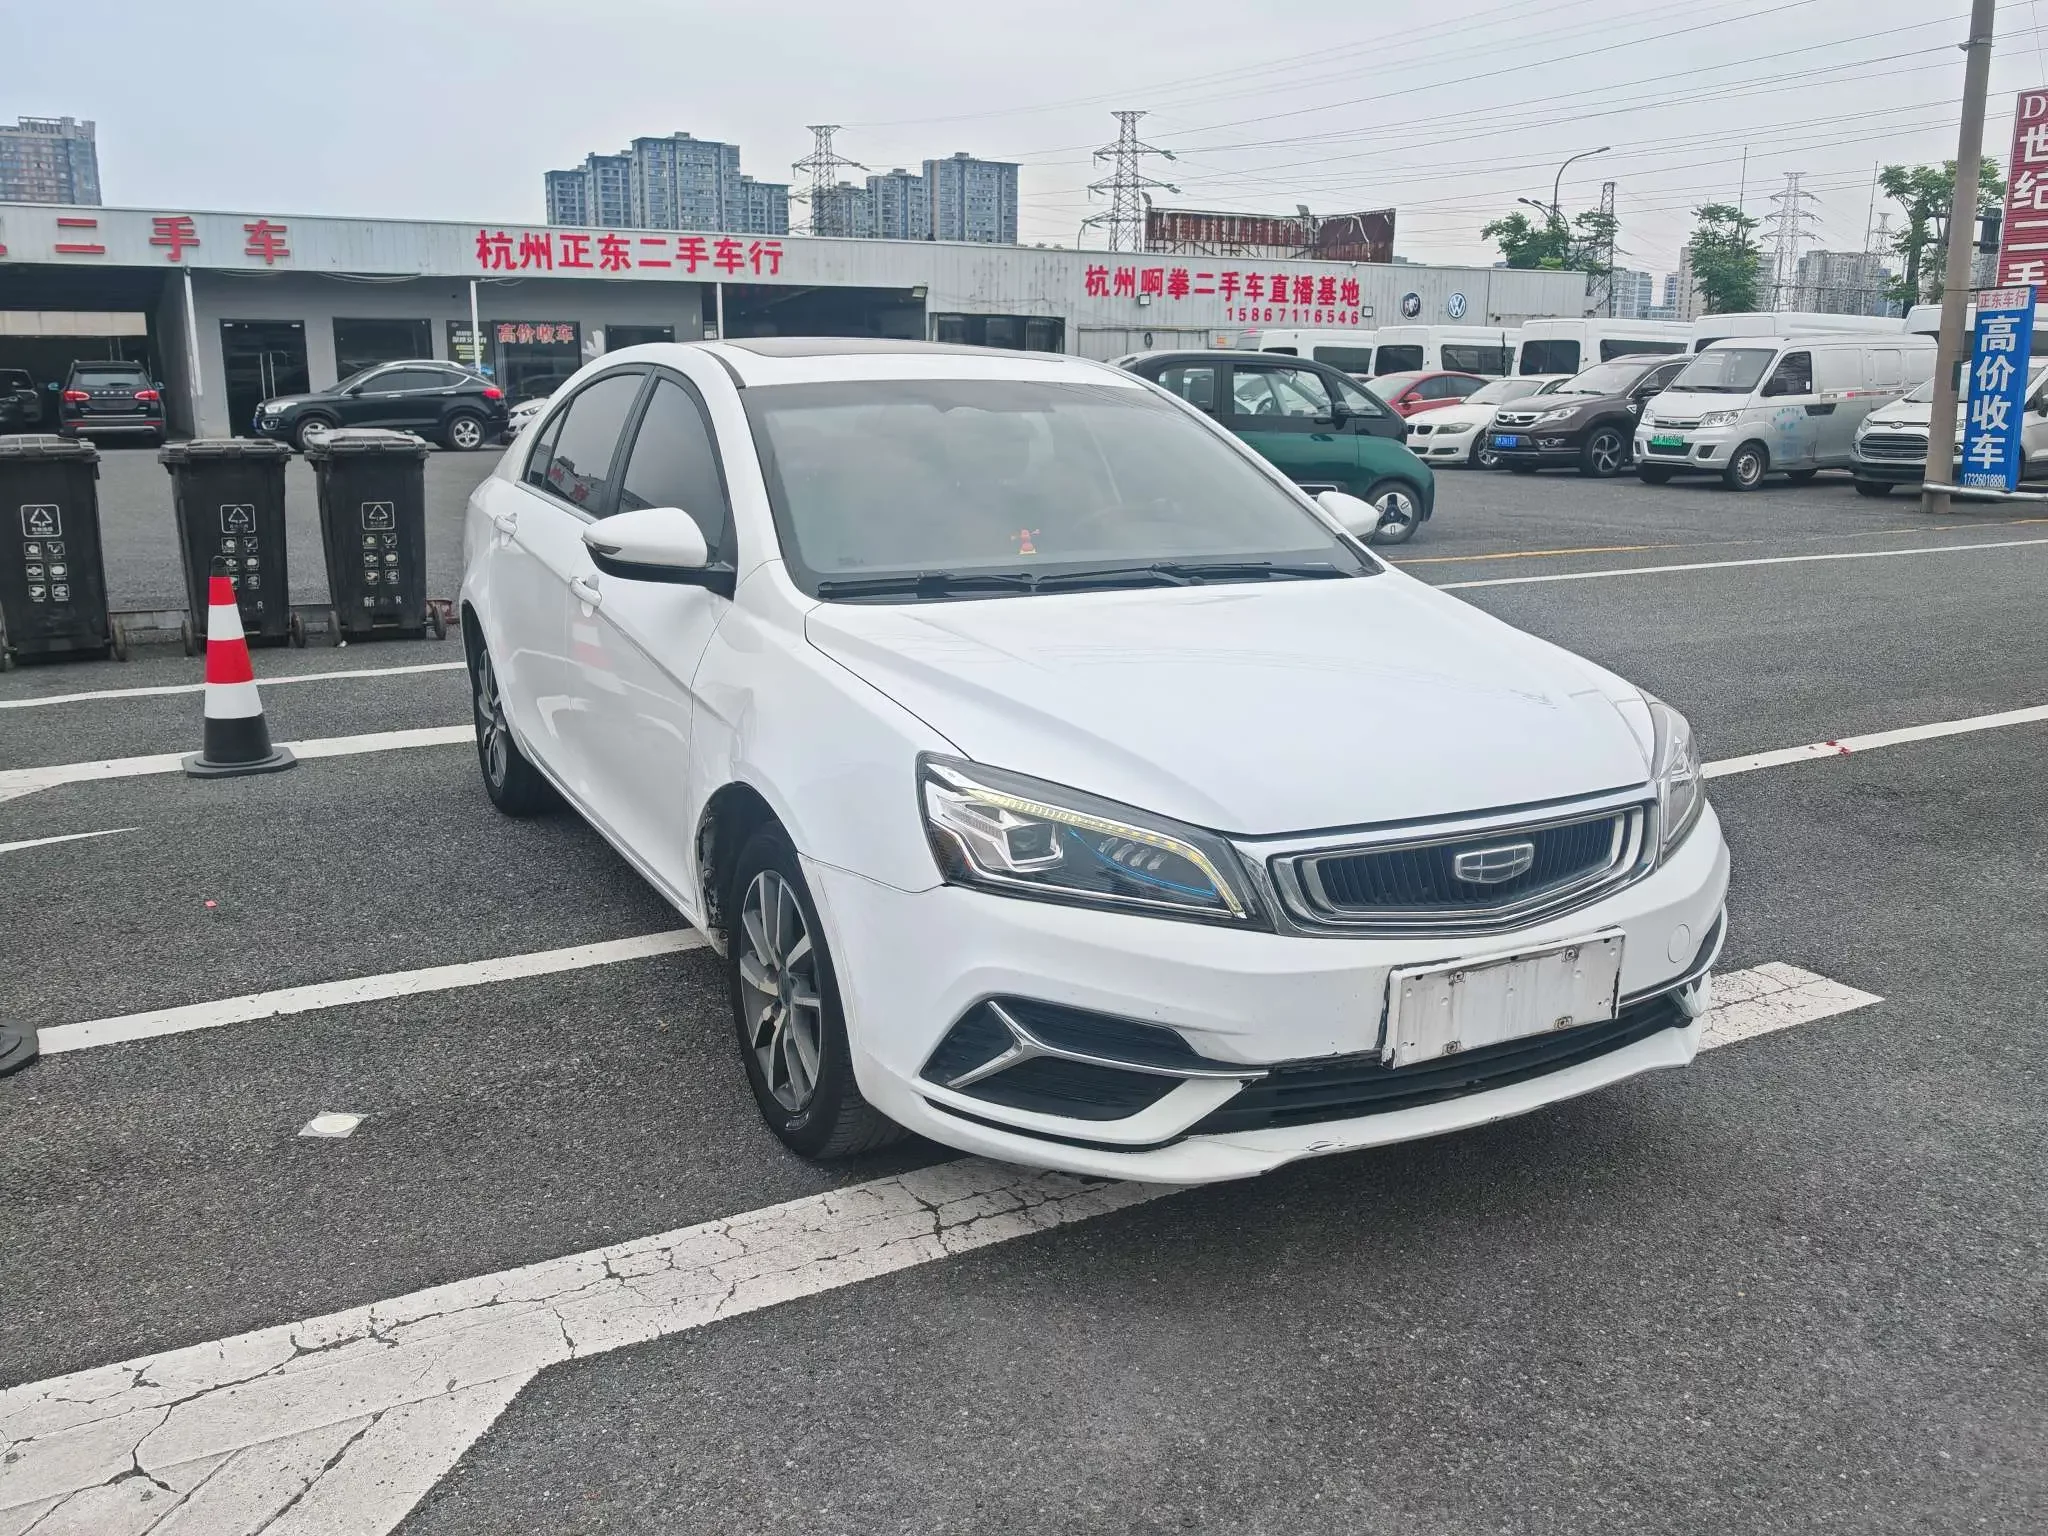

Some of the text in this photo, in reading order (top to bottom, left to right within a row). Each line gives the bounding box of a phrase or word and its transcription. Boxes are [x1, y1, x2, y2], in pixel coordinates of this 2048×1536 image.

[2023, 95, 2048, 119] D
[0, 216, 290, 264] 二手车
[475, 229, 784, 275] 杭州正东二手车行
[1979, 289, 2027, 308] 正东车行
[1226, 307, 1359, 324] 15867116546
[498, 323, 574, 344] 高价收车
[1968, 315, 2020, 469] 高价收车
